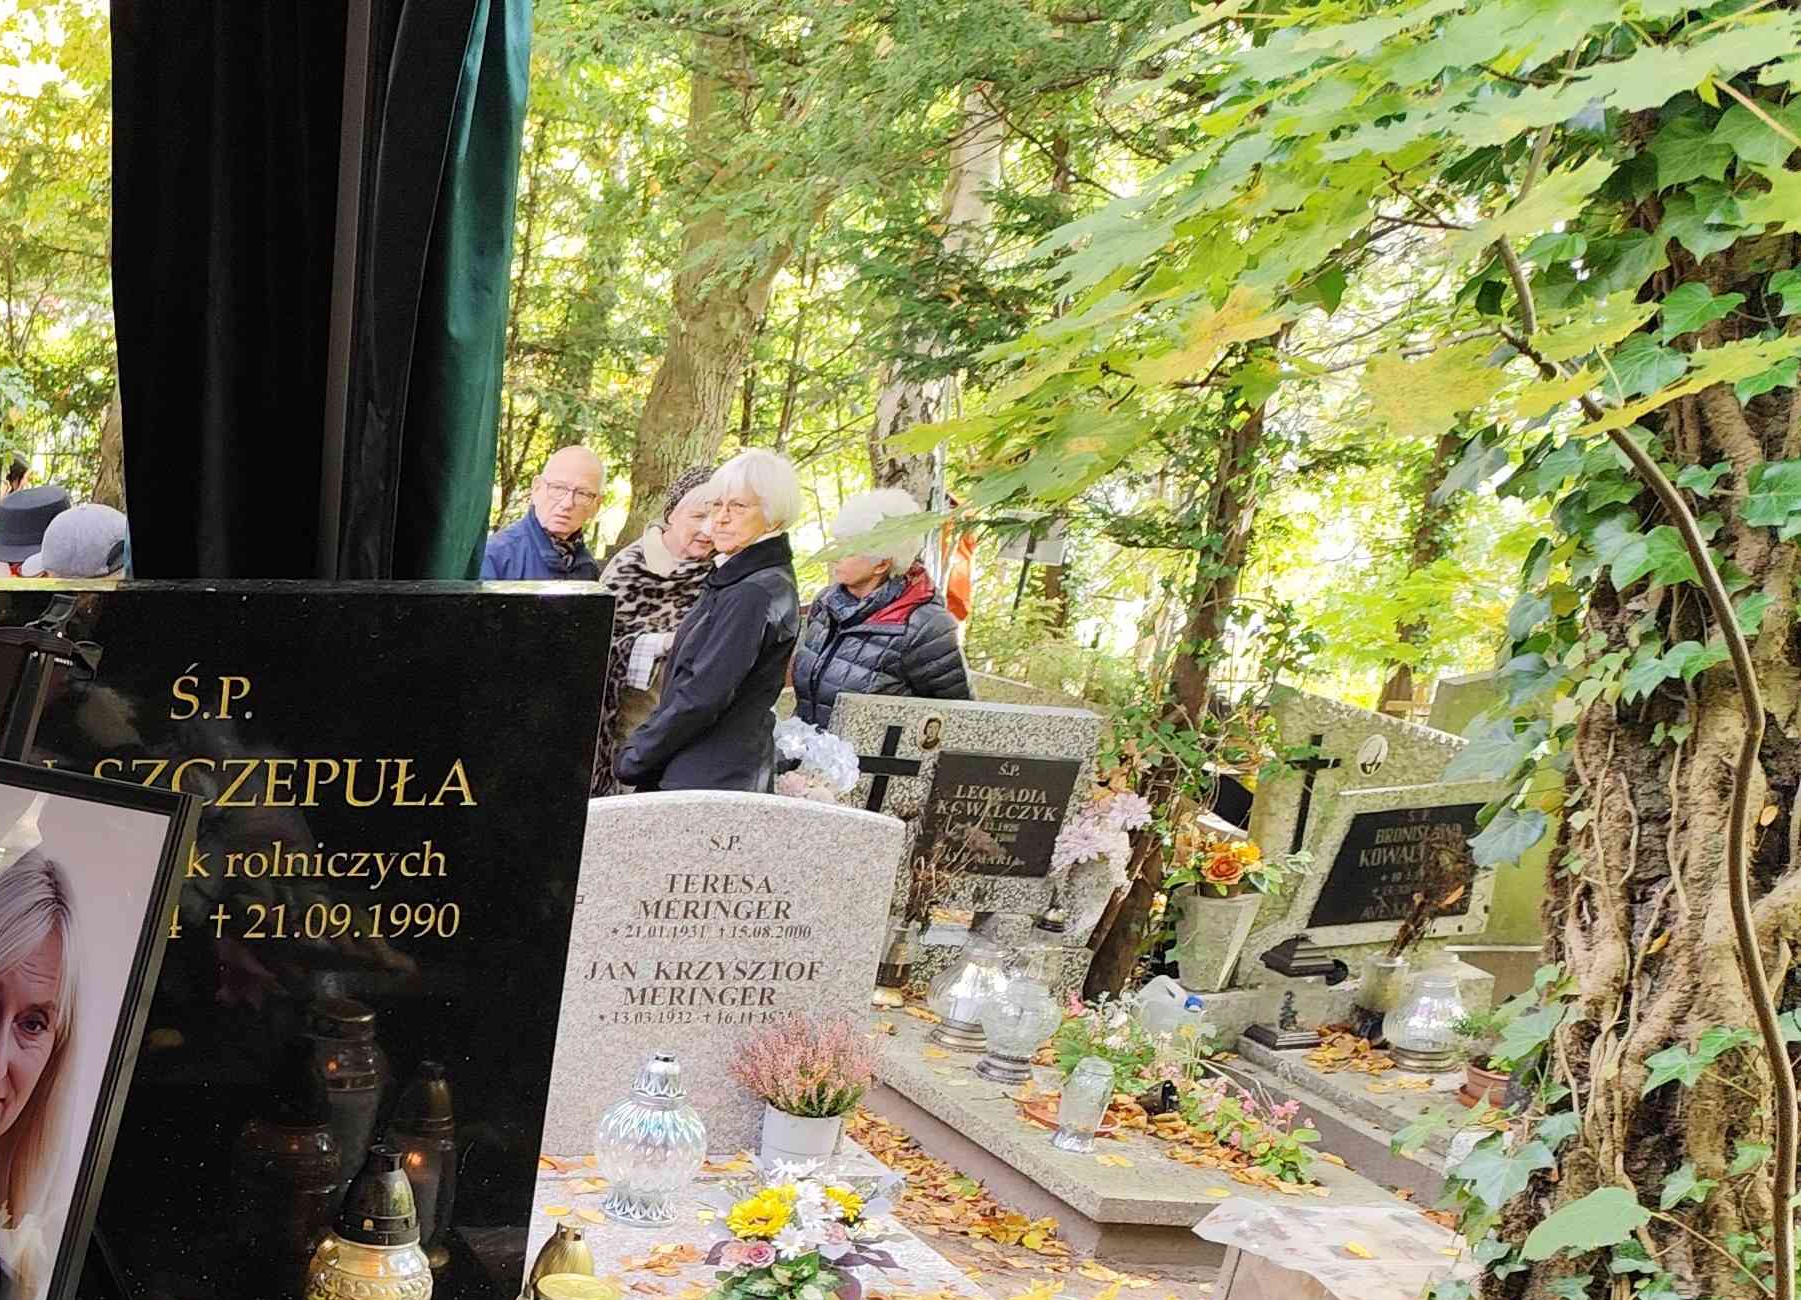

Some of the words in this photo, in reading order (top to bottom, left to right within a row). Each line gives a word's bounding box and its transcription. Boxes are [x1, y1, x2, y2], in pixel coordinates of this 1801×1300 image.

[170, 662, 254, 721] Ś.P.
[225, 840, 448, 890] rolniczych
[665, 873, 774, 895] TERESA
[243, 902, 461, 940] 21.09.1990
[637, 899, 793, 921] MERINGER
[584, 961, 638, 981] JAN
[654, 960, 824, 982] KRZYSZTOF
[622, 986, 777, 1008] MERINGER
